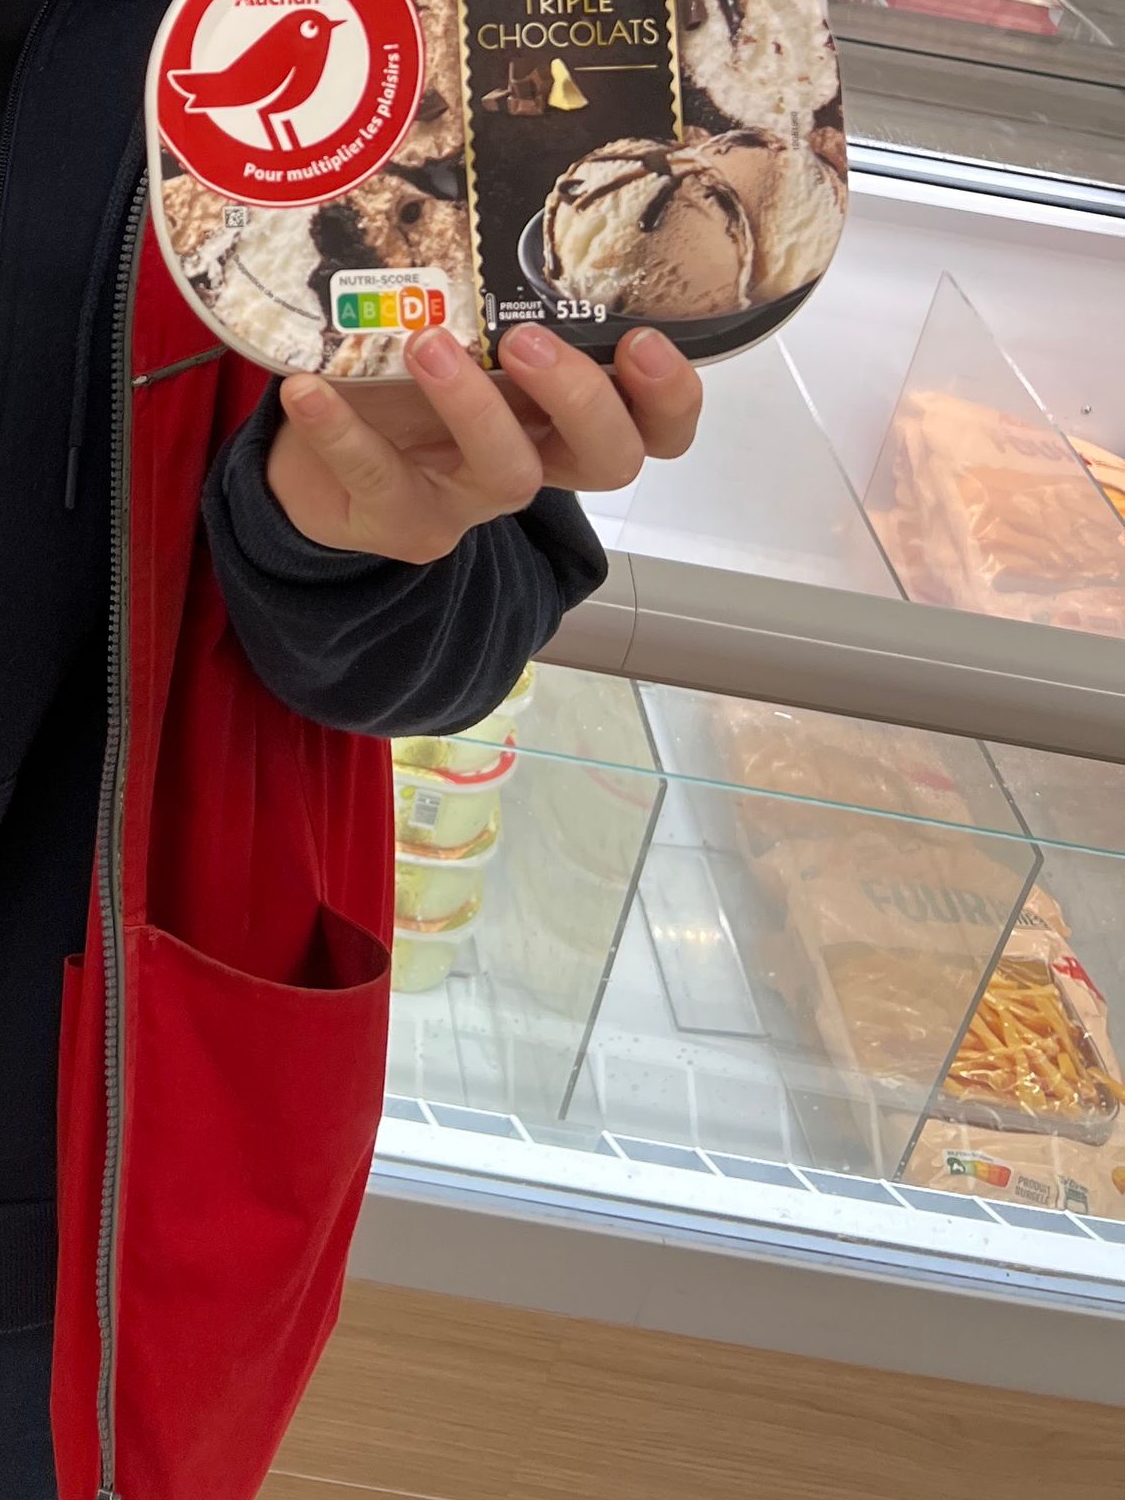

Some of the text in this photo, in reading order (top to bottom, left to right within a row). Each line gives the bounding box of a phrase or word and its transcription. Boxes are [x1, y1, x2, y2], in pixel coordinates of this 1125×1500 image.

[477, 18, 660, 50] CHOCOLATS
[243, 162, 284, 182] Pour
[287, 136, 365, 181] multiplier
[359, 115, 385, 140] les
[376, 52, 401, 118] plaisirs
[339, 273, 420, 286] NUTRI-SCORE
[341, 302, 357, 320] A
[363, 301, 376, 318] B
[403, 296, 423, 320] D
[431, 299, 443, 316] E
[499, 308, 545, 320] SURGELÉ
[500, 301, 542, 311] PRODUIT
